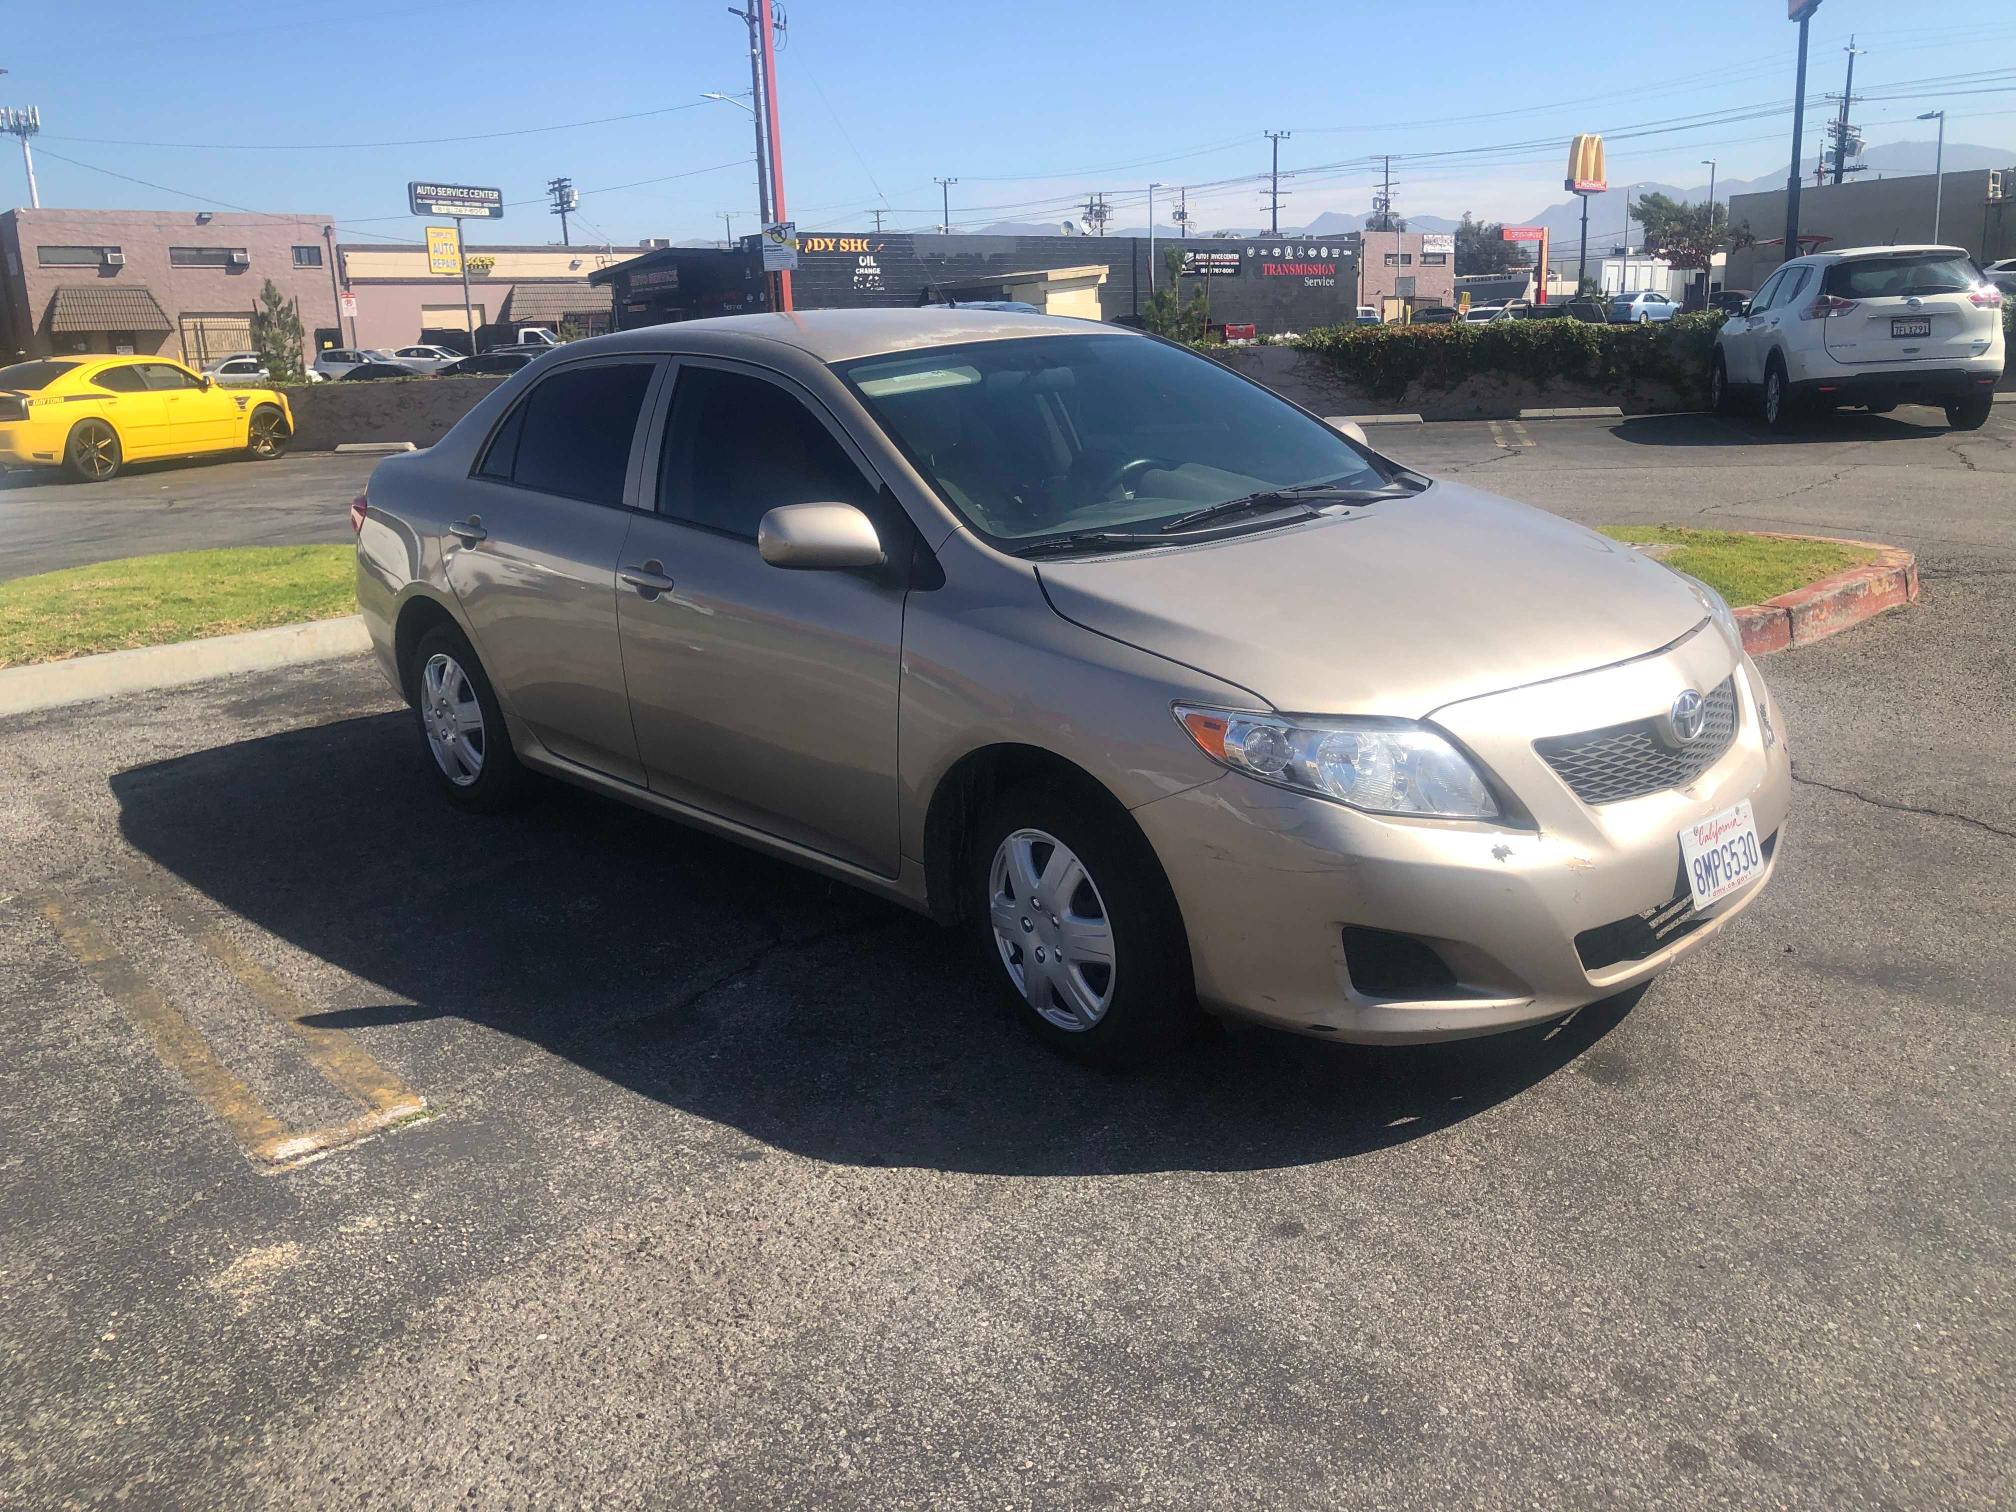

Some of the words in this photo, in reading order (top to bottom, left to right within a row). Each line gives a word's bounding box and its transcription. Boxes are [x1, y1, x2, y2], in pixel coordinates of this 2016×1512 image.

[417, 185, 436, 195] AUTO
[437, 187, 469, 198] SERVICE
[469, 190, 499, 199] CENTER
[433, 242, 455, 255] AUTO
[432, 258, 457, 269] REPAIR
[858, 255, 877, 266] OIL
[855, 267, 881, 275] CHANGE
[1262, 263, 1337, 276] TRANSMISSION
[1304, 276, 1335, 287] Service
[1698, 818, 1742, 846] California
[1693, 831, 1759, 897] 8MPG530
